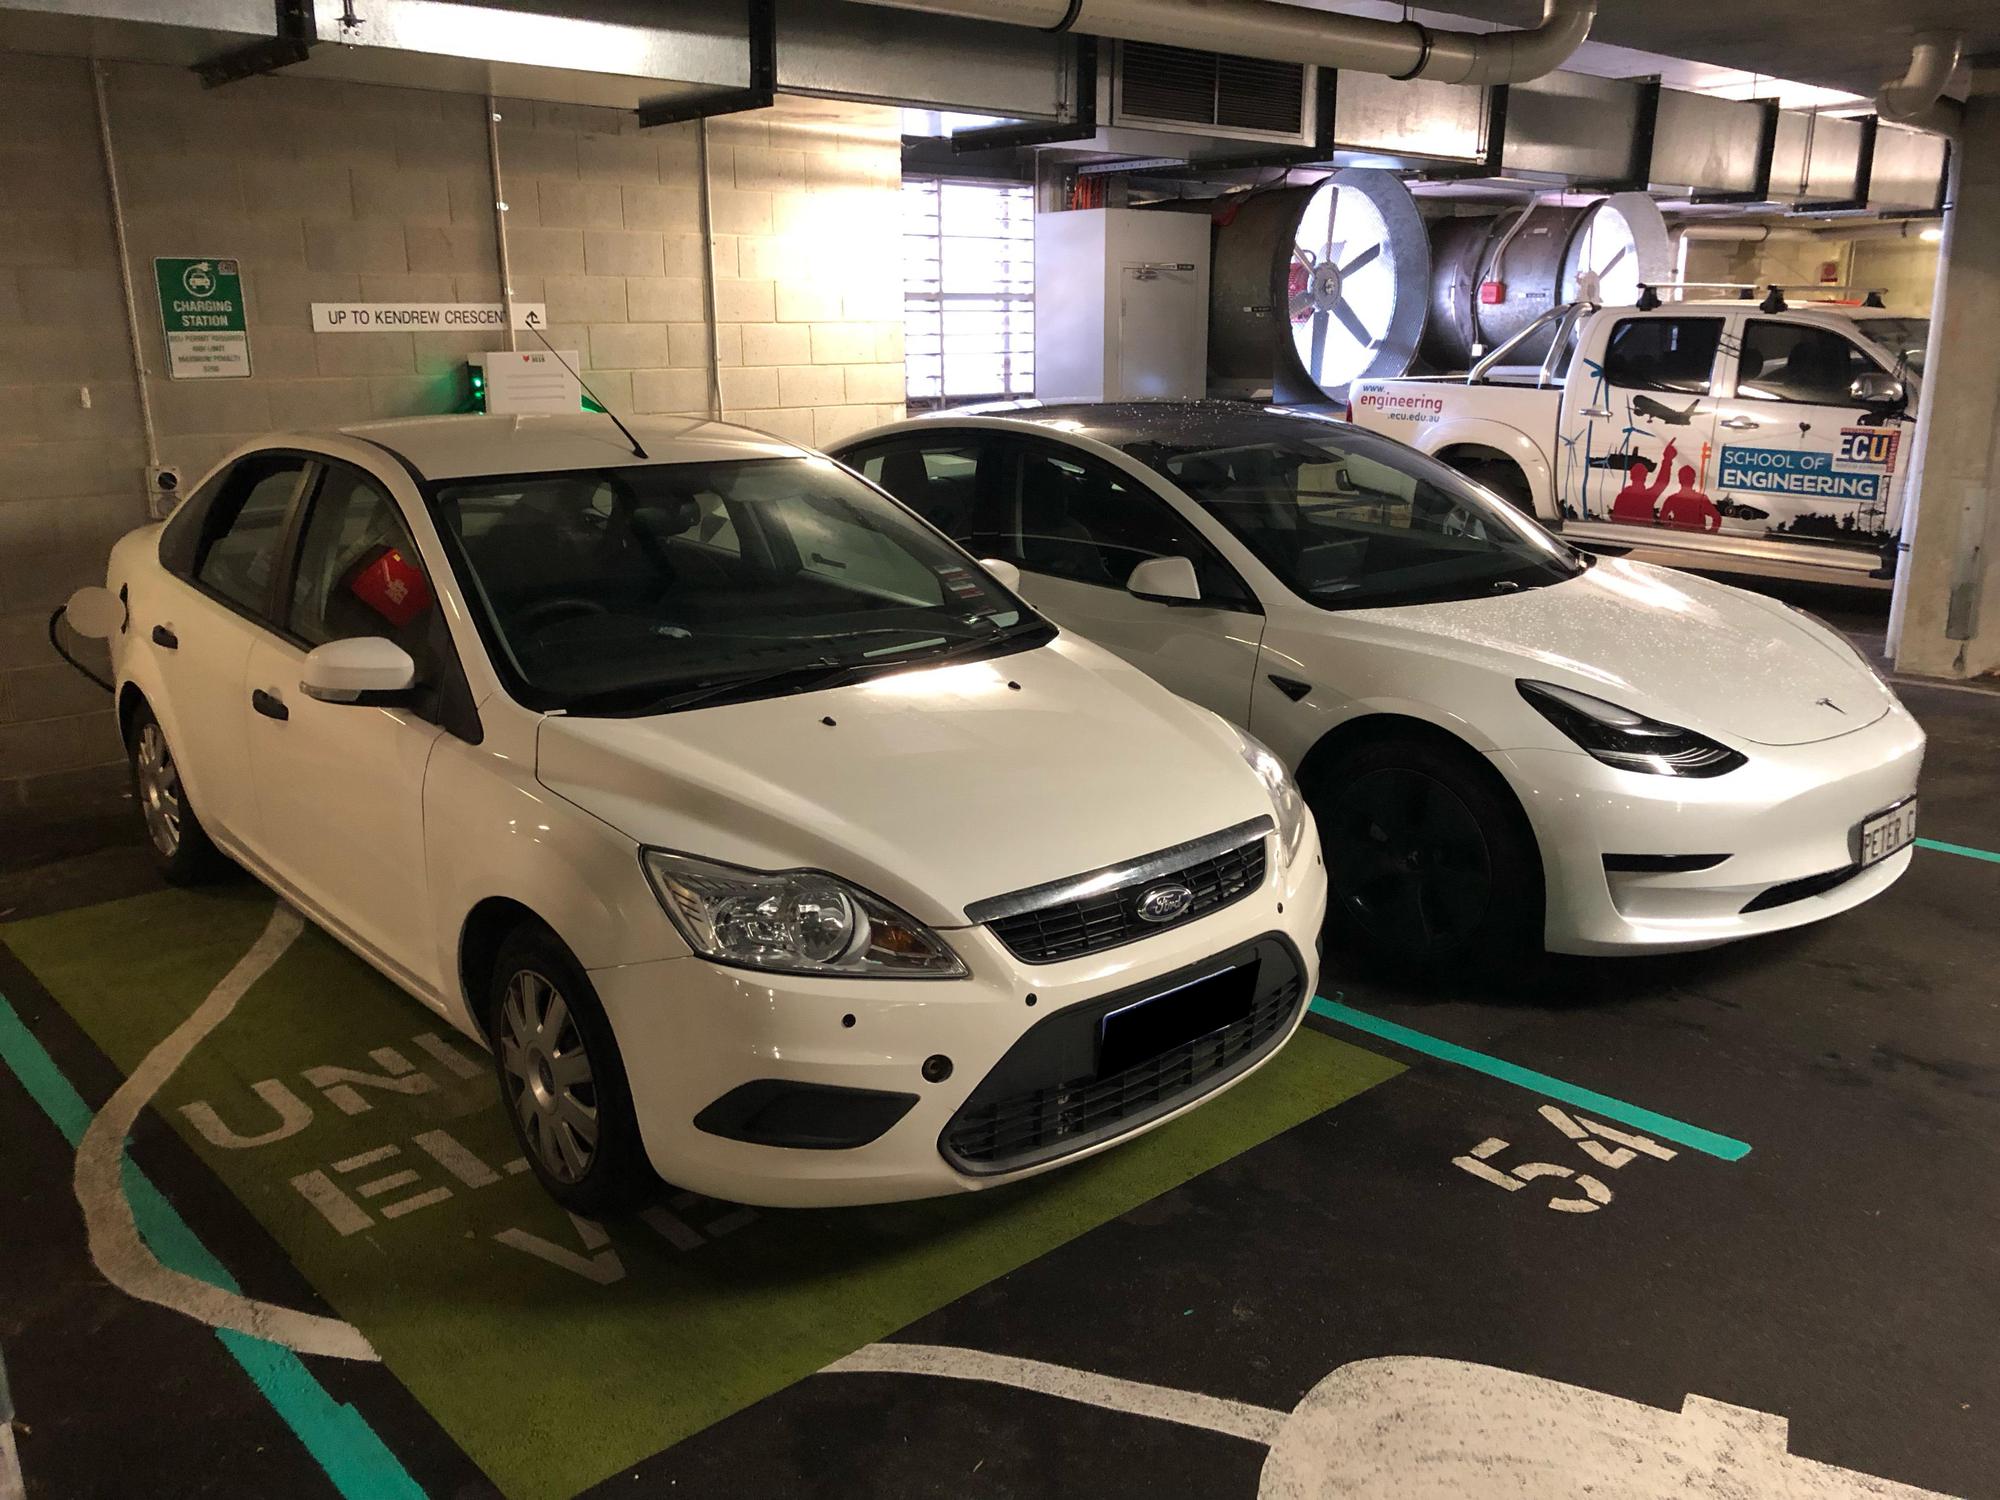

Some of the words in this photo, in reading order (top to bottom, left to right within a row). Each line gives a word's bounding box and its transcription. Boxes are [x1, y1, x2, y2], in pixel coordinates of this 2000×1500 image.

[173, 300, 232, 312] CHARGING
[182, 314, 228, 327] STATION
[328, 311, 346, 325] UP
[351, 310, 370, 325] TO
[375, 310, 440, 325] KENDREW
[445, 309, 507, 324] CRESCEN
[1360, 392, 1443, 413] engineering
[1840, 434, 1889, 462] ECU
[1724, 451, 1795, 469] SCHOOL
[1800, 455, 1825, 470] OF
[1723, 468, 1873, 497] ENGINEERING
[1153, 893, 1181, 914] Ford
[177, 1032, 486, 1149] UNI
[1451, 1104, 1678, 1213] 54
